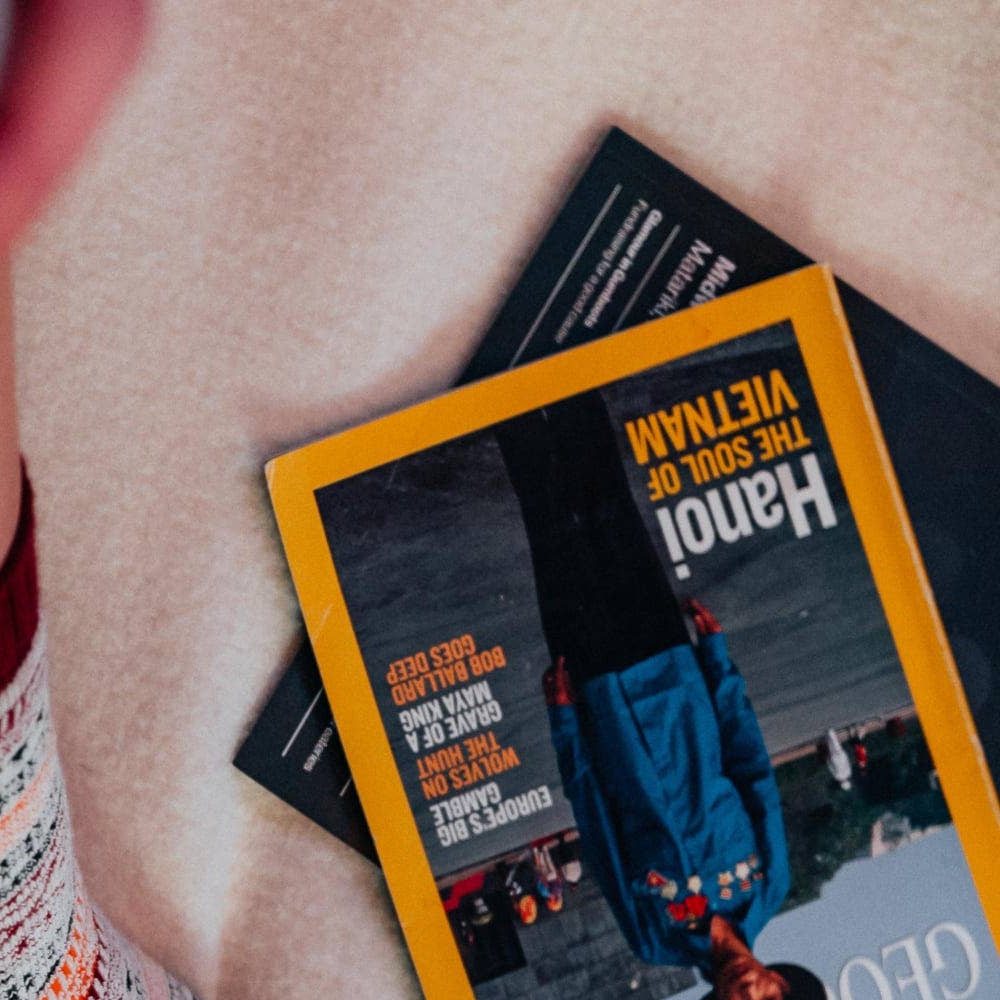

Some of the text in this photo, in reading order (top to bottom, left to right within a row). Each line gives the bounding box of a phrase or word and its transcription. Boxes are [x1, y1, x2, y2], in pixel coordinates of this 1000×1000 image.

[584, 209, 663, 328] Glamour in Gumboots
[596, 261, 611, 277] for
[572, 281, 595, 314] good
[624, 368, 799, 465] VIETNAM
[647, 416, 812, 501] THE SOUL OF
[655, 452, 838, 580] Hanoi
[385, 634, 476, 685] GOES DEEP
[391, 645, 507, 706] BOB BALLARD
[399, 680, 493, 732] MAYA KING
[405, 700, 503, 753] GRAVE OF A
[303, 727, 333, 773] eateries
[416, 730, 501, 780] THE HUNT
[421, 746, 521, 800] WOLVES ON
[429, 781, 501, 827] GAMBLE
[437, 785, 553, 847] EUROPE'S BIG
